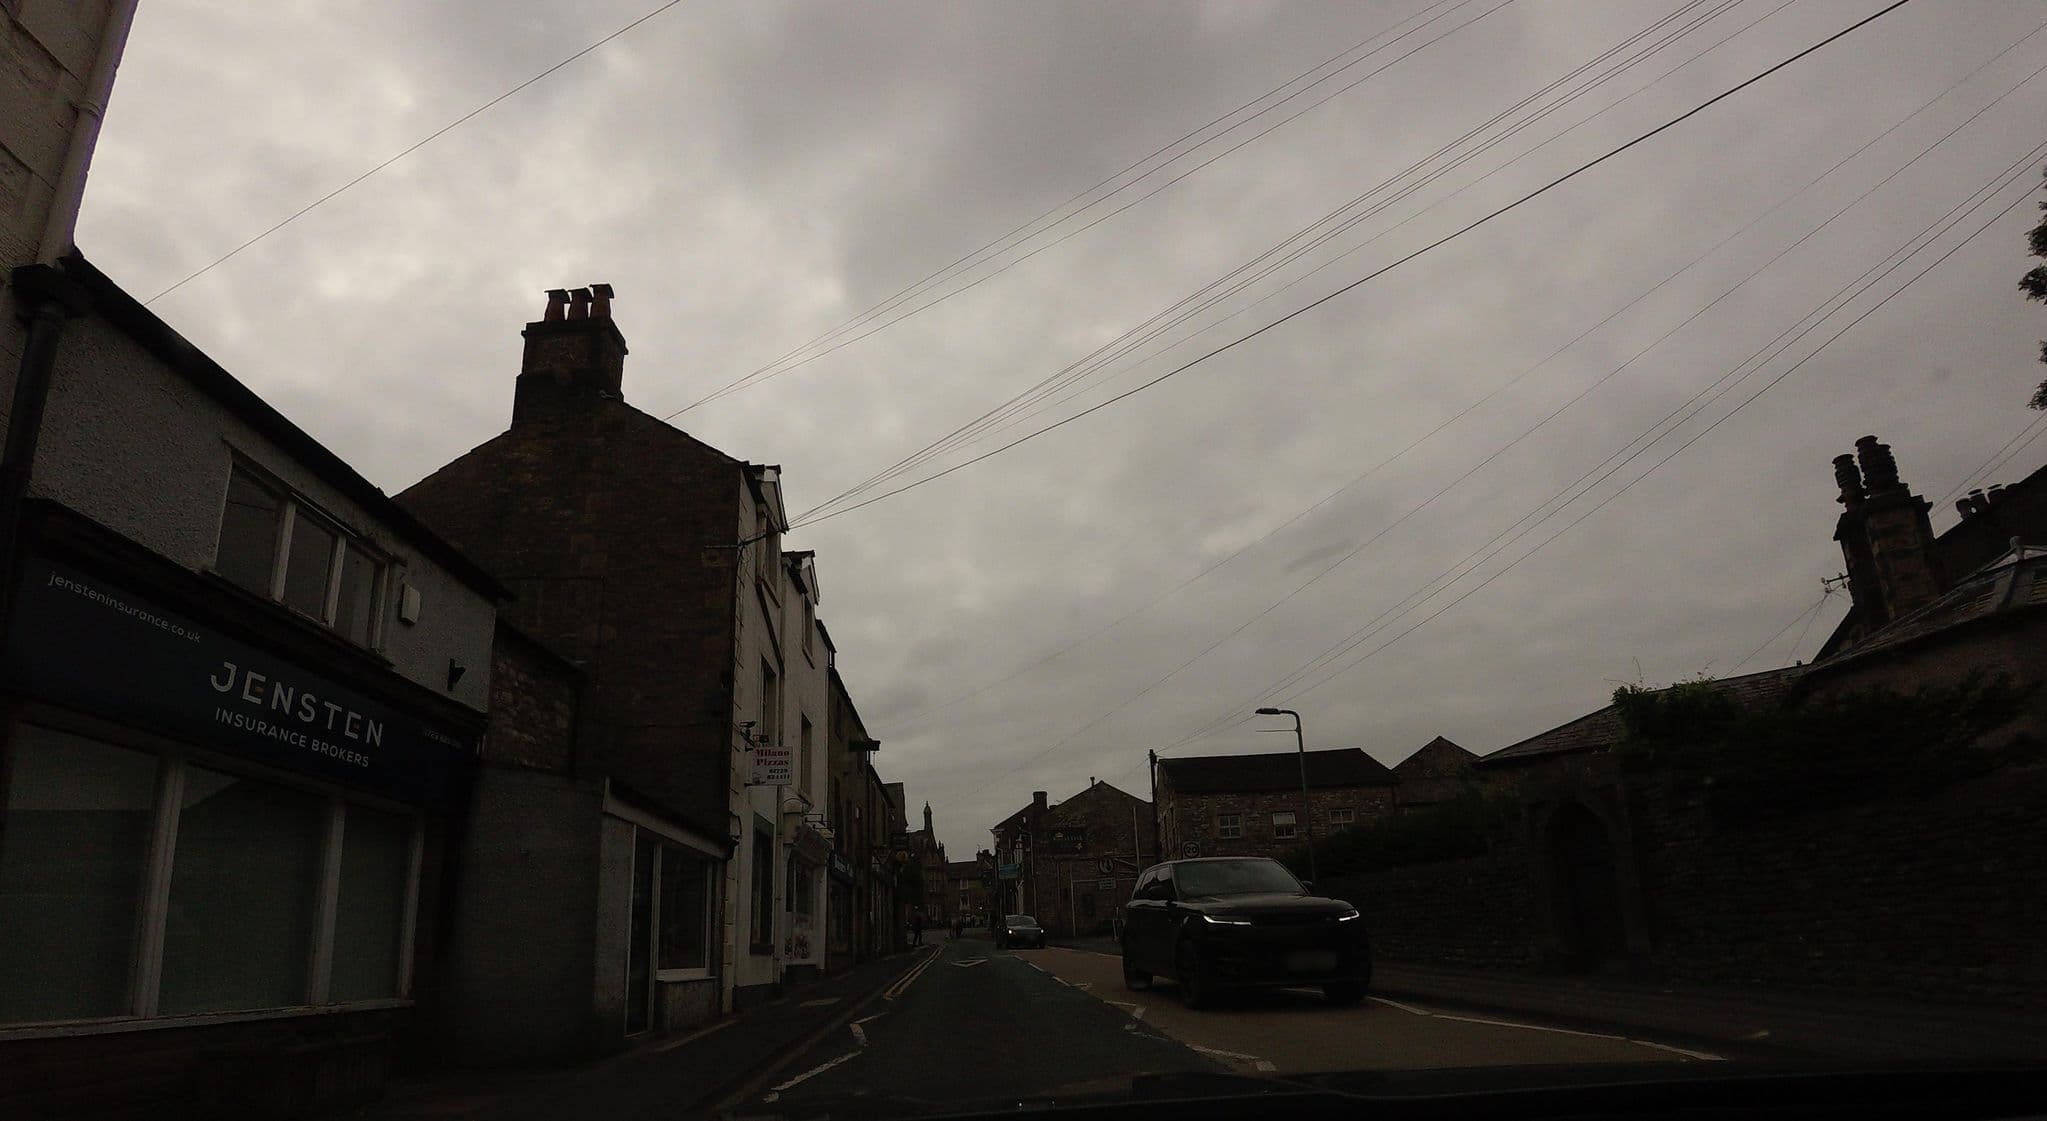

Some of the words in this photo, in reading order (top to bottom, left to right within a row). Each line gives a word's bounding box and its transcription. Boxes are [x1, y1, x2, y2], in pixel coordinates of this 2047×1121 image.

[47, 570, 202, 644] jensteninsurance.co.uk
[210, 661, 384, 748] JENSTEN
[215, 707, 308, 748] INSURANCE
[311, 739, 370, 768] BROKERS
[756, 758, 790, 766] Pizzas
[1186, 846, 1198, 854] 20
